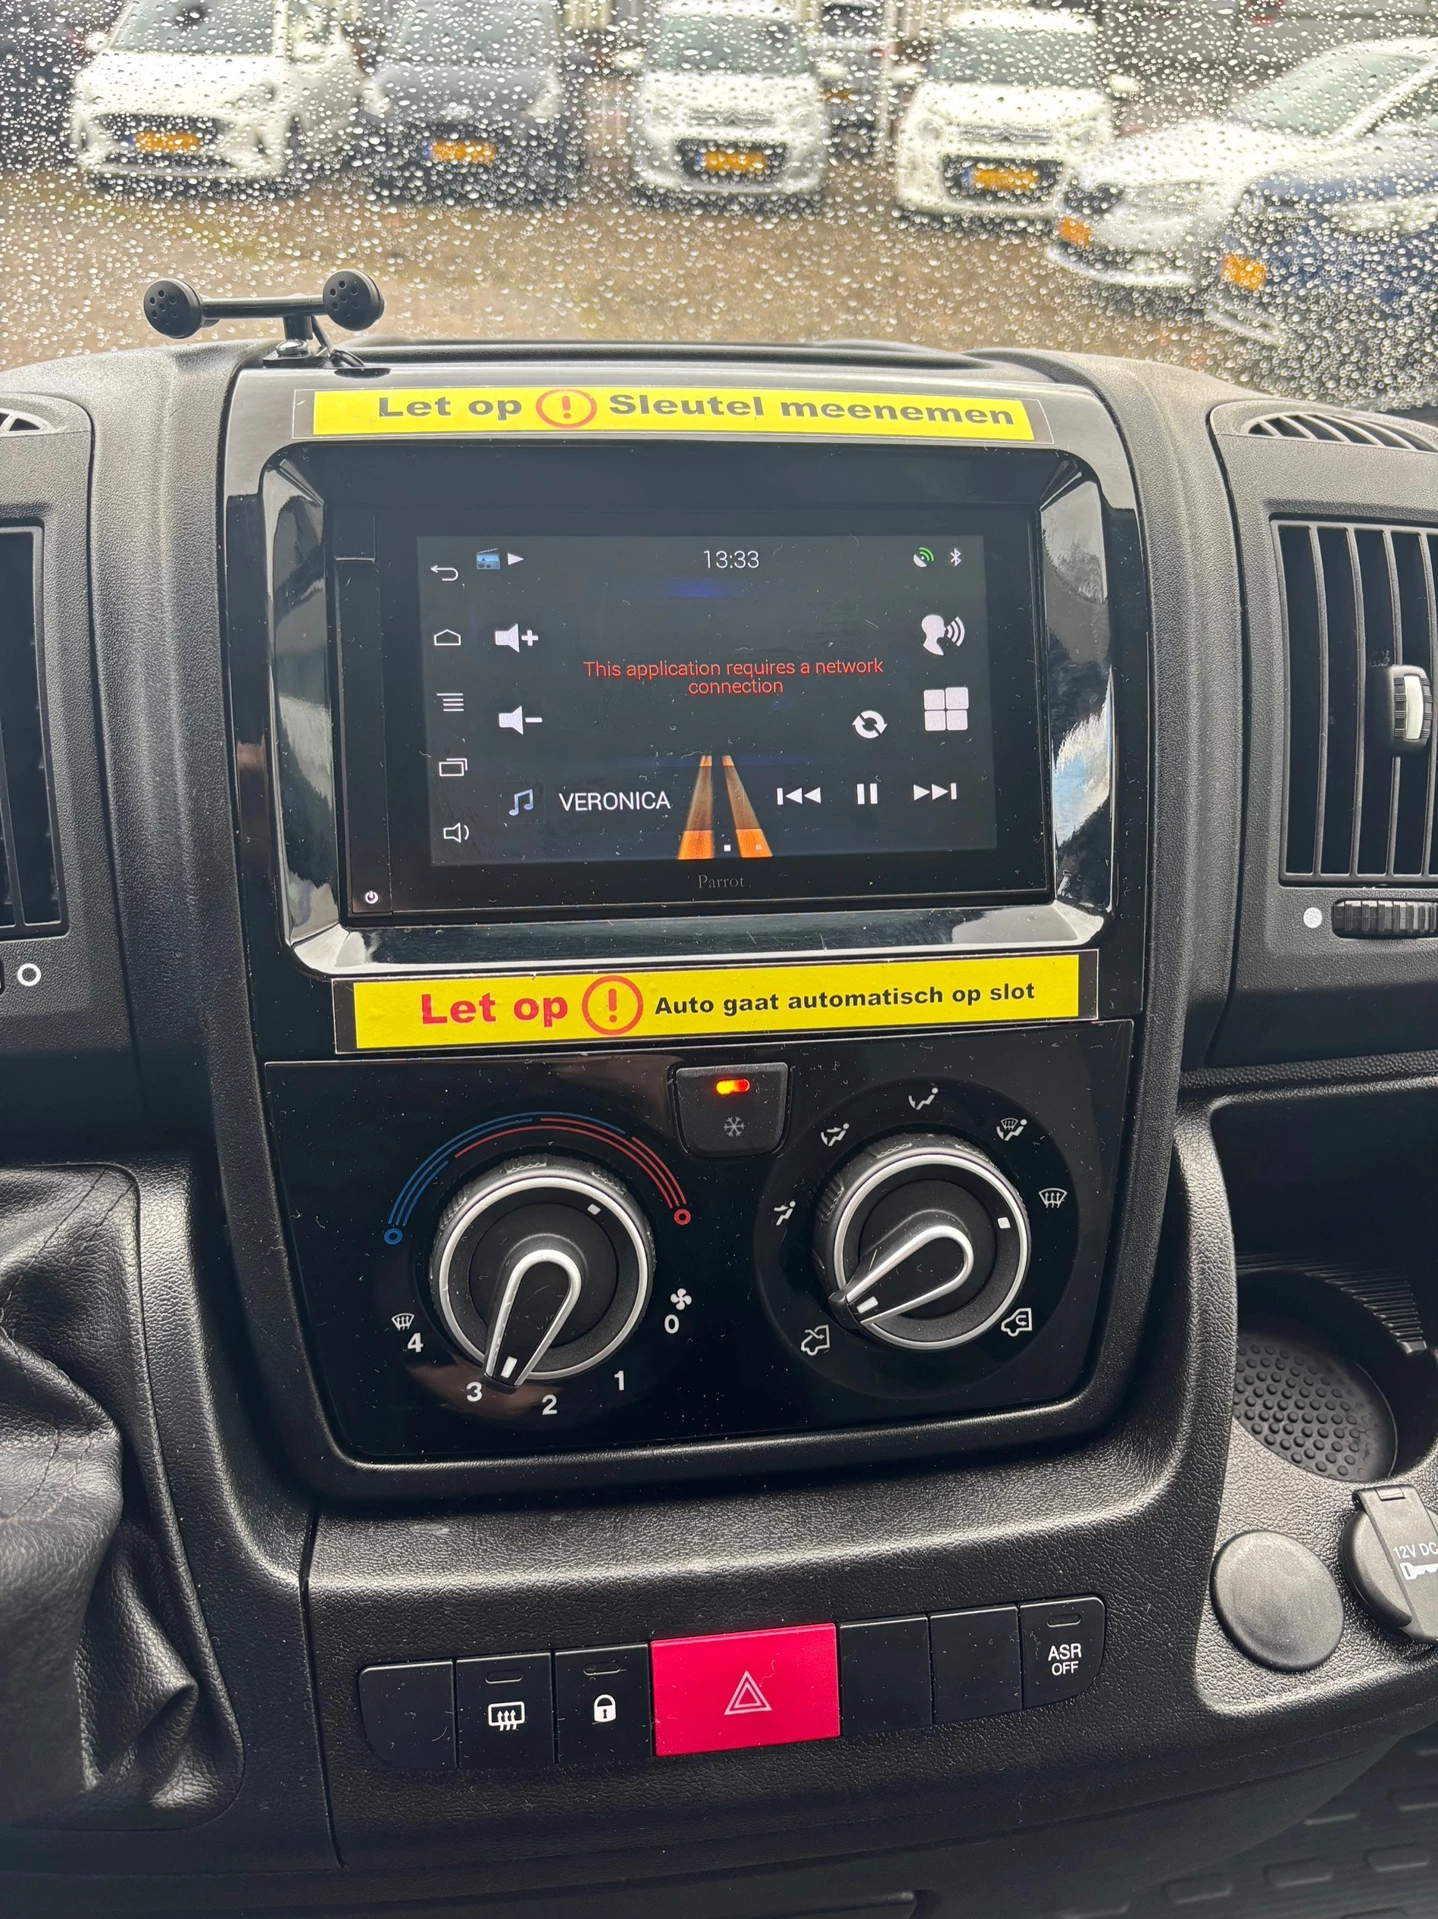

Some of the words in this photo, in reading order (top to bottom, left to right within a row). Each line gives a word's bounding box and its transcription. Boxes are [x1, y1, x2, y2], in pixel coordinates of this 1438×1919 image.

[379, 396, 452, 418] Let
[467, 398, 523, 420] op
[608, 393, 765, 418] Sleutel
[780, 400, 1015, 425] meenemen
[702, 549, 760, 570] 13:33
[583, 661, 621, 677] This
[626, 660, 721, 681] application
[726, 660, 796, 681] requires
[799, 662, 811, 675] a
[815, 657, 884, 675] network
[687, 679, 784, 695] connection
[558, 791, 672, 812] VERONICA
[697, 874, 746, 889] Parrot
[420, 992, 497, 1025] Let
[513, 995, 569, 1028] op
[654, 995, 715, 1016] Auto
[722, 994, 779, 1016] gaat
[787, 985, 943, 1010] automatisch
[951, 987, 981, 1006] op
[989, 982, 1035, 1002] slot
[664, 1314, 680, 1334] 0
[407, 1333, 424, 1353] 4
[614, 1370, 625, 1391] 1
[466, 1381, 483, 1402] 3
[542, 1394, 558, 1416] 2
[1393, 1544, 1417, 1560] 12V
[1419, 1541, 1438, 1556] DC
[1048, 1643, 1082, 1661] ASR
[1051, 1661, 1079, 1676] OFF
